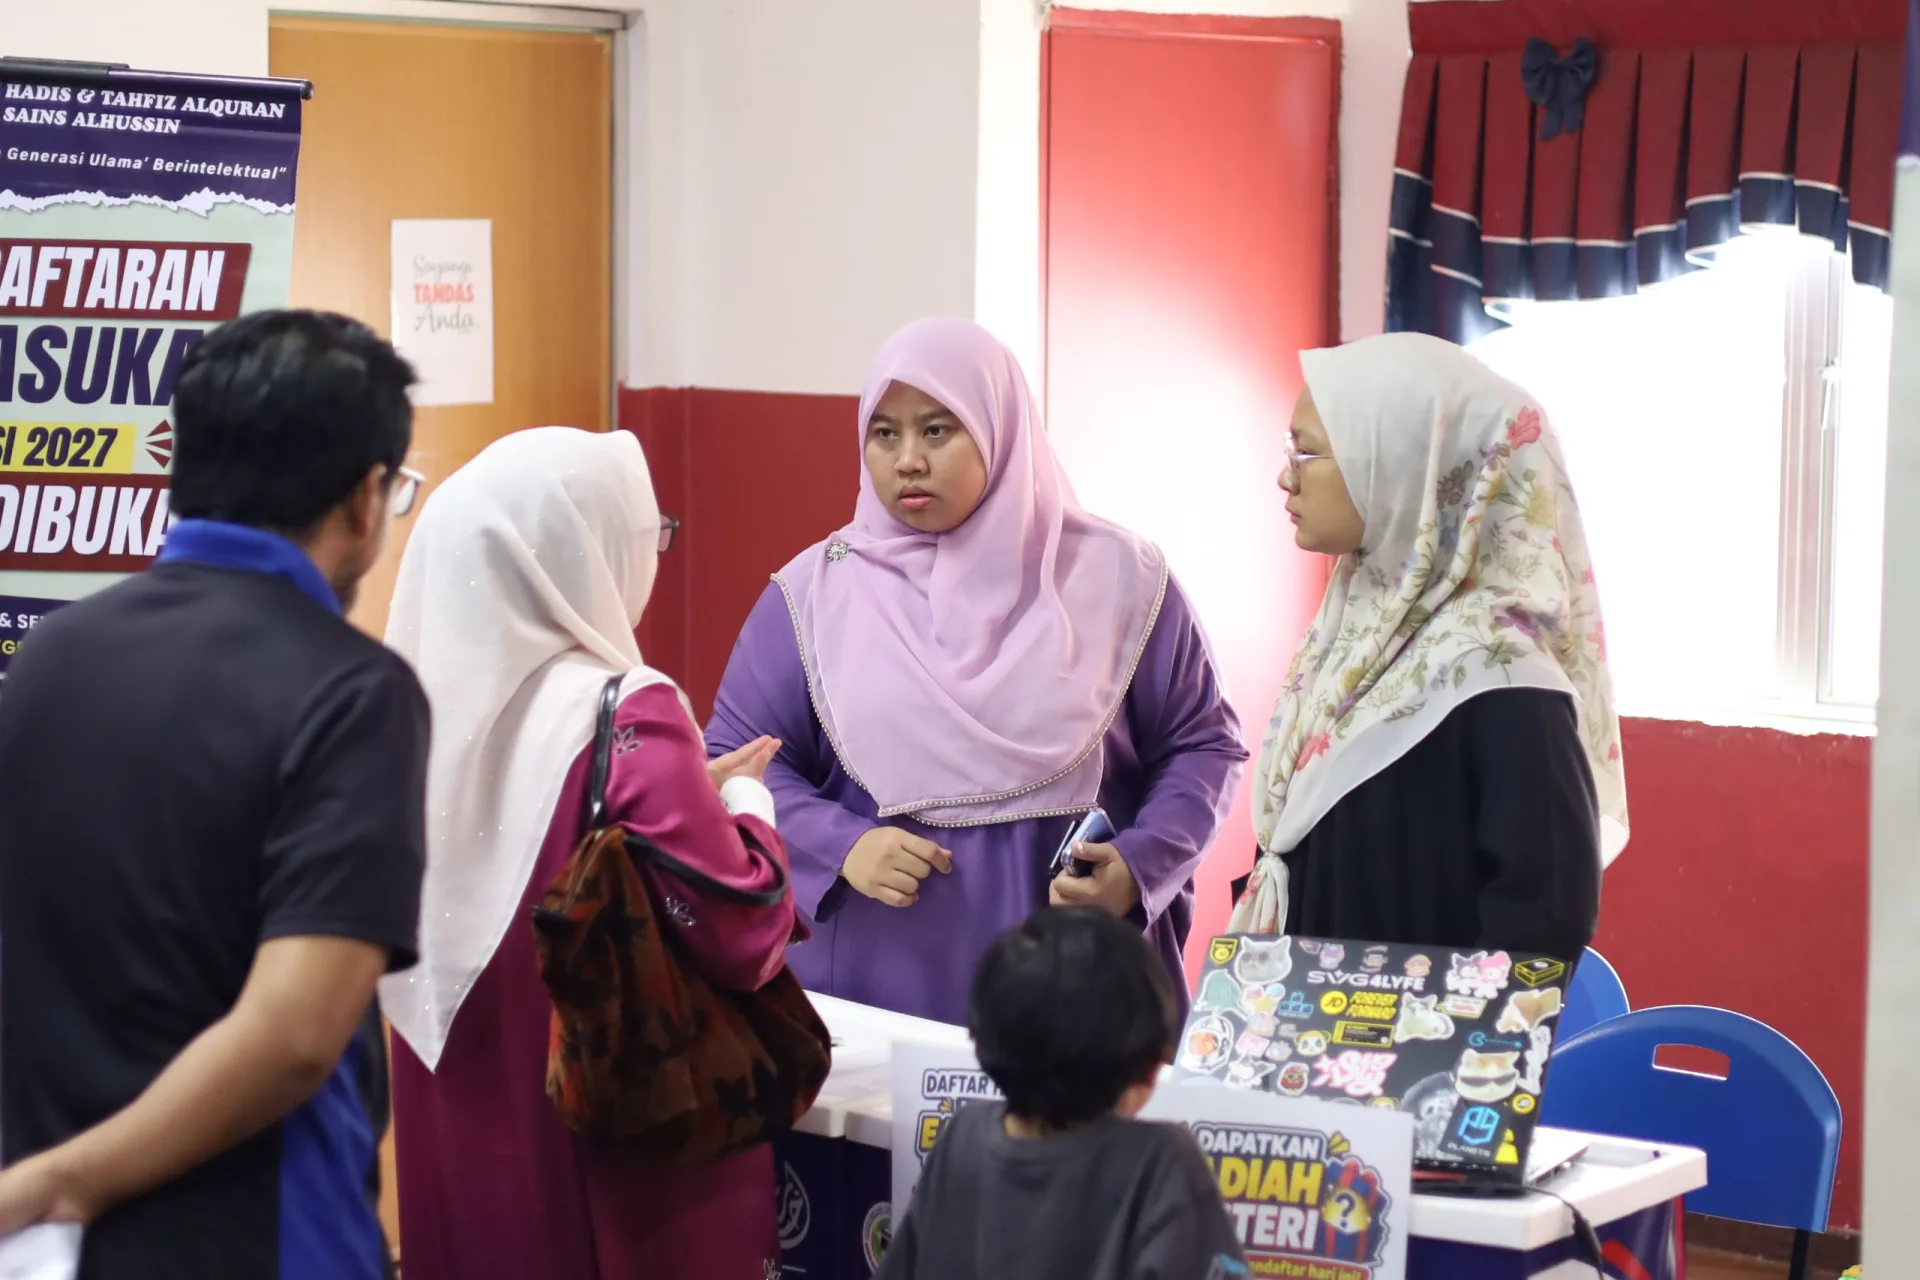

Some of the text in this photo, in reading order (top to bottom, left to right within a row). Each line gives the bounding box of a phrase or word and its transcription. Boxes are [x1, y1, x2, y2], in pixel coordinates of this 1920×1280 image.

[5, 84, 286, 118] HADIS & TAHFIZ ALQURAN
[3, 107, 181, 134] SAINS ALHUSSIN
[7, 147, 84, 165] Generasi
[0, 245, 225, 311] AFTARAN
[414, 283, 474, 304] TANDAS
[23, 426, 118, 467] 2027
[926, 1075, 989, 1094] DAFTAR
[1200, 1129, 1320, 1159] DAPATKAN
[1205, 1156, 1323, 1205] DIAH
[1224, 1202, 1319, 1250] TERI
